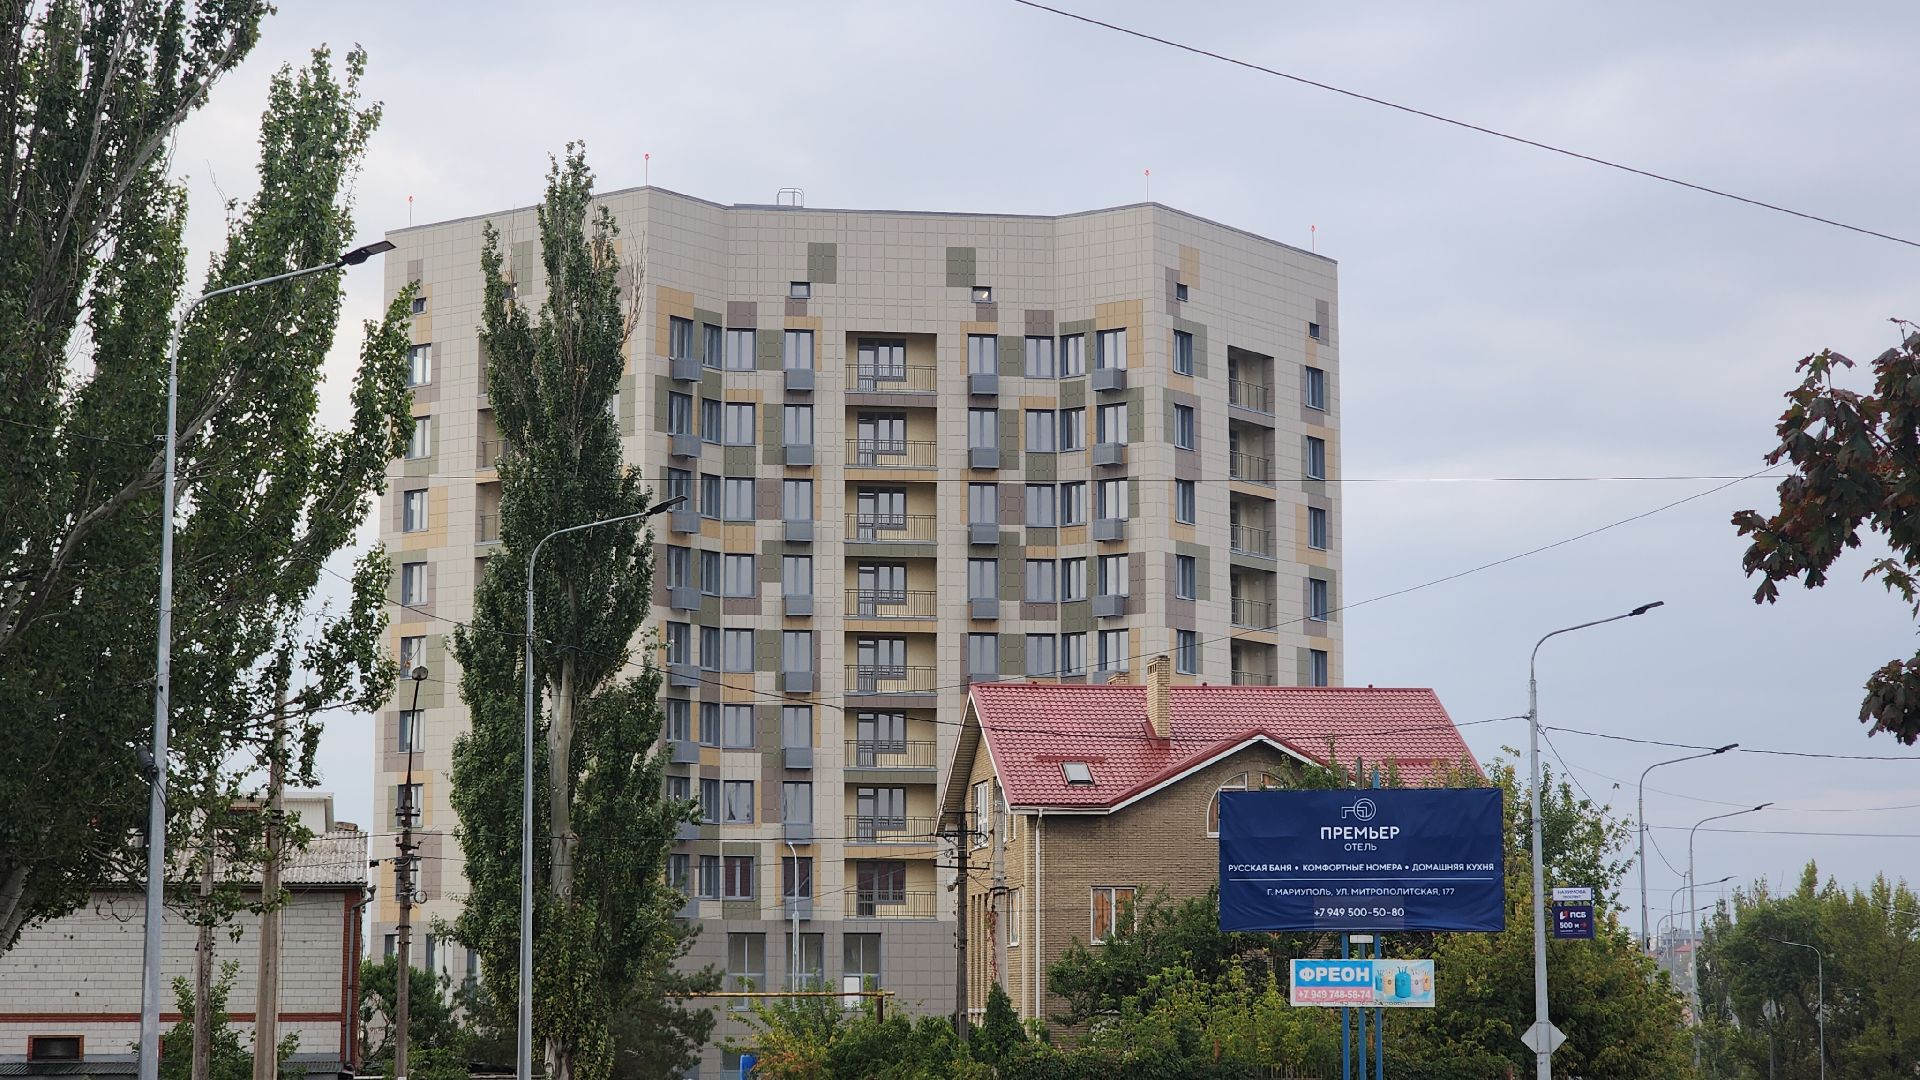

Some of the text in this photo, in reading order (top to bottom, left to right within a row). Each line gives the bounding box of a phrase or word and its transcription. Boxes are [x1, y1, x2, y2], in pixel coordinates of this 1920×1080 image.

[1320, 826, 1400, 840] ПРЕМЬЕР
[1344, 843, 1378, 851] ОТЕЛЬ
[1228, 863, 1495, 872] РУССКАЯ БАНЯ КОМФОРТНЫЕ НОМЕРА ДОМАШНЯЯ КУХНЯ
[1267, 887, 1455, 897] Г. МАРИУПОЛЬ, УЛ. МИТРОПОЛИТСКАЯ, 177
[1314, 908, 1405, 917] +7 949 500-50-80
[1299, 966, 1370, 982] ФРЕОН
[1298, 990, 1309, 999] +7
[1311, 990, 1328, 999] 949
